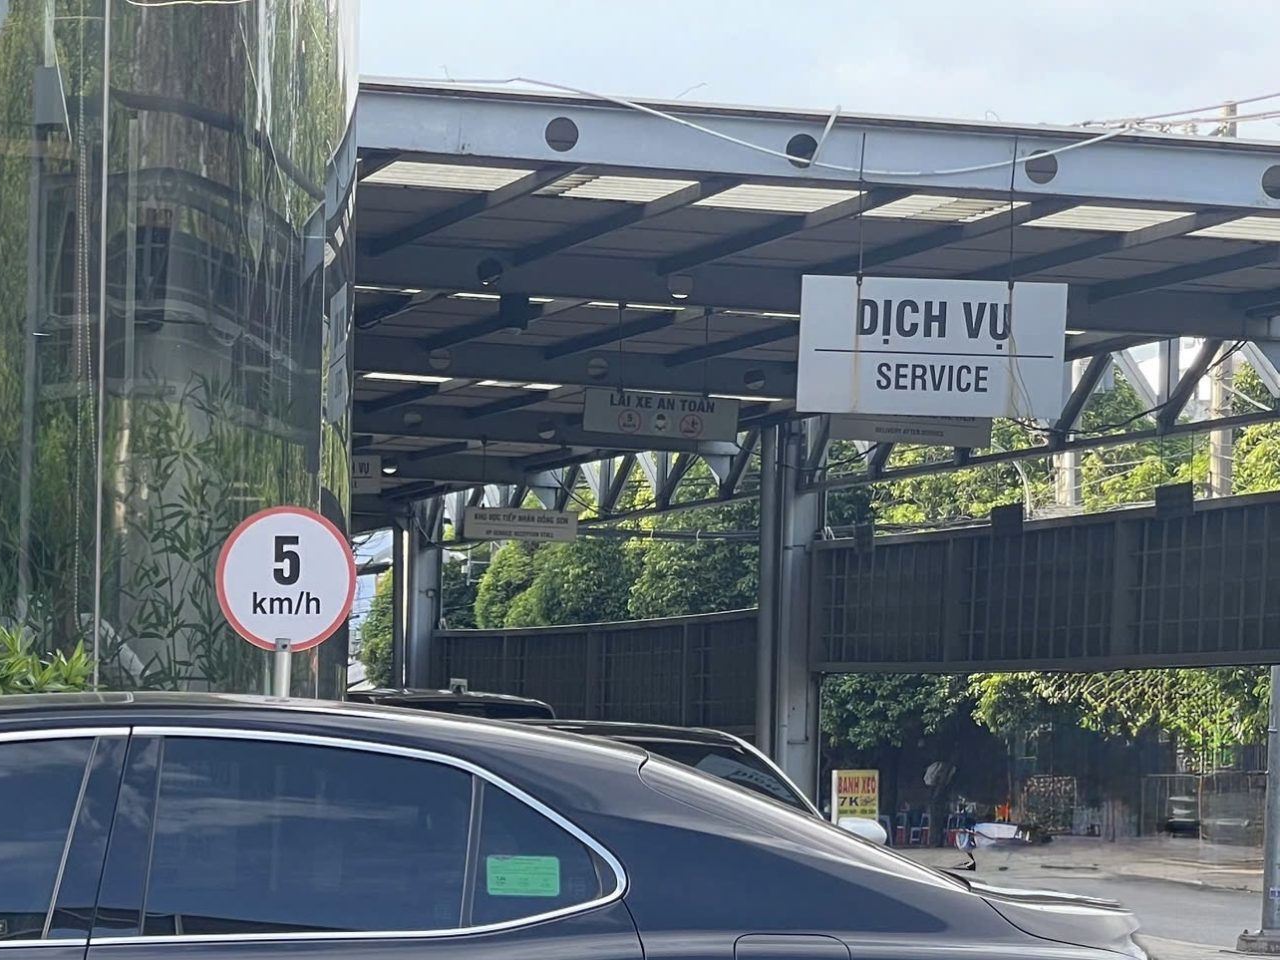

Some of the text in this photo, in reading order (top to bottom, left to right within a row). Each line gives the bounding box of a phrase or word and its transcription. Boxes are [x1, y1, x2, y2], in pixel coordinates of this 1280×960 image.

[857, 298, 1012, 350] DỊCH VỤ
[876, 362, 990, 393] SERVICE
[635, 395, 653, 409] XE
[657, 397, 676, 411] AN
[273, 535, 301, 586] 5
[252, 591, 321, 615] km/h
